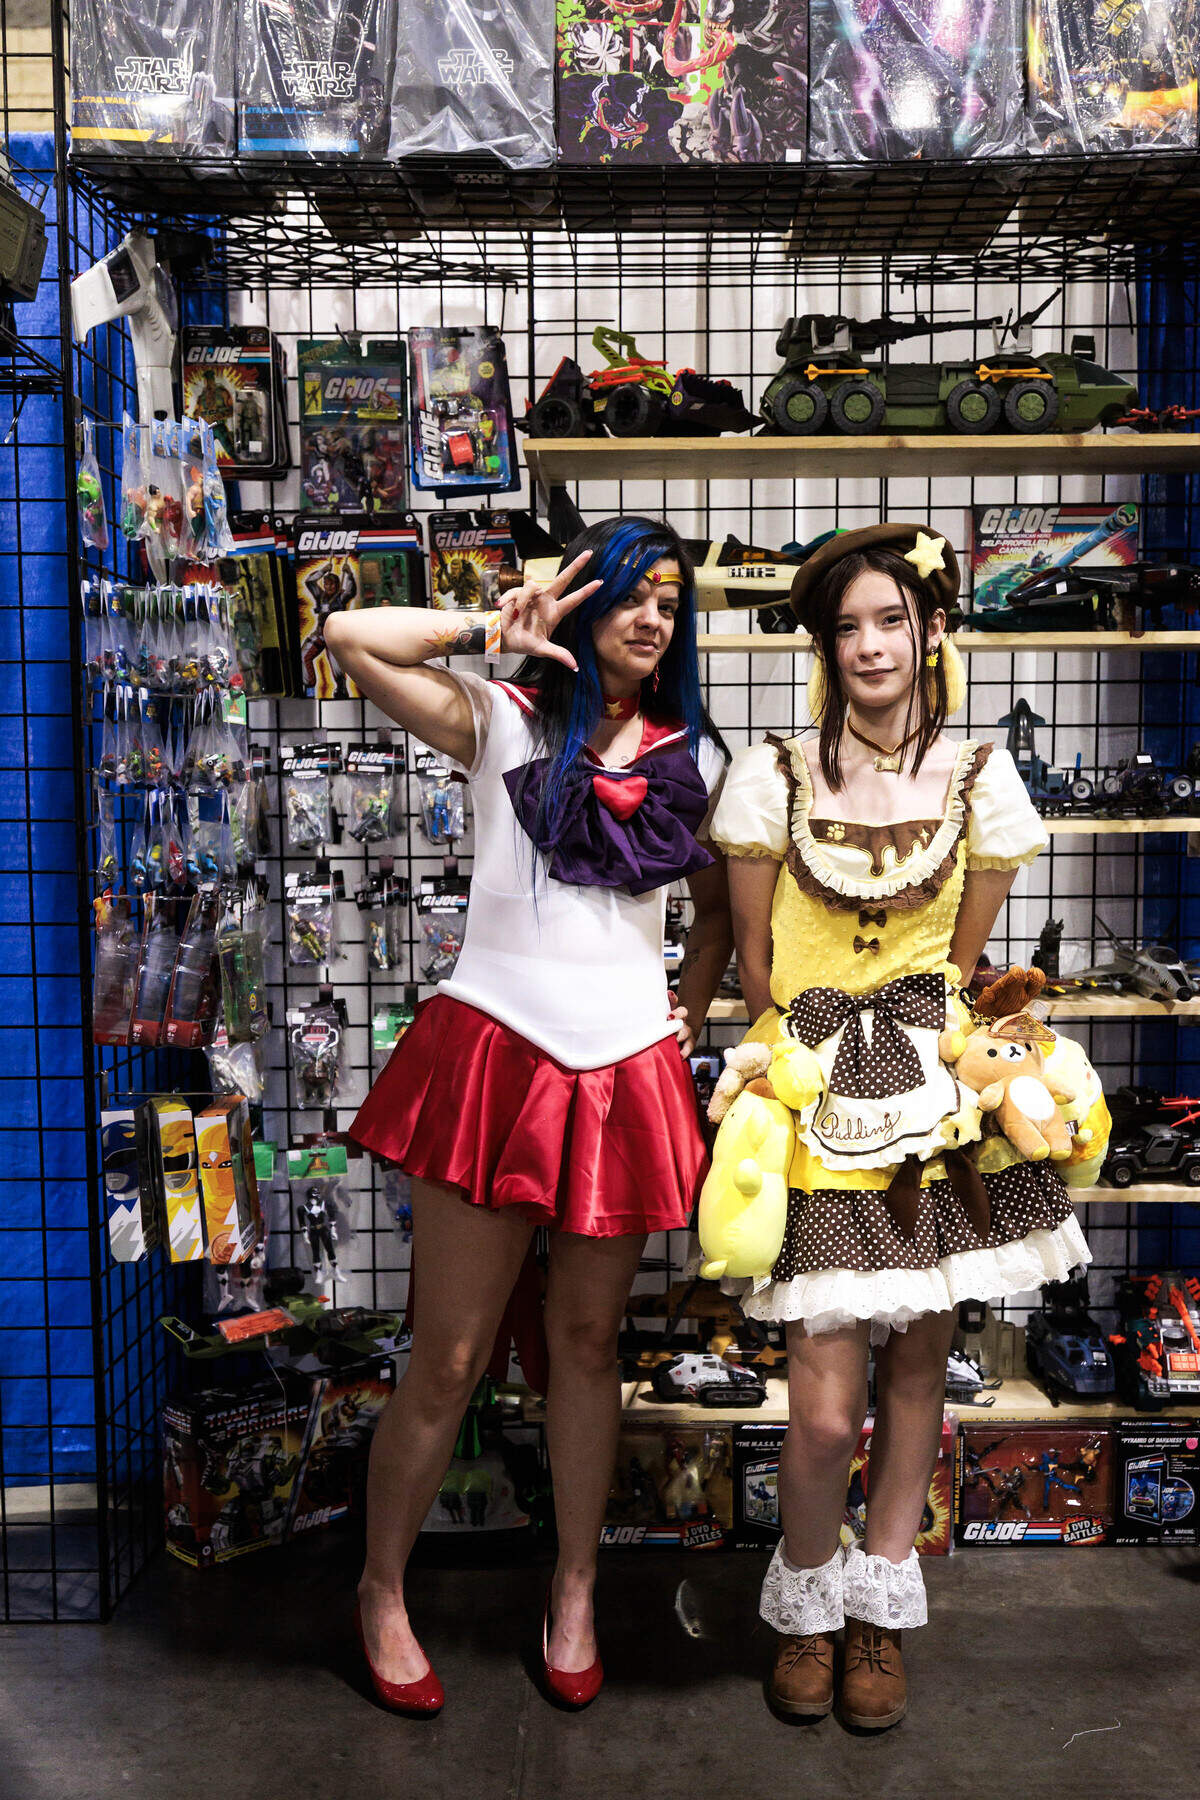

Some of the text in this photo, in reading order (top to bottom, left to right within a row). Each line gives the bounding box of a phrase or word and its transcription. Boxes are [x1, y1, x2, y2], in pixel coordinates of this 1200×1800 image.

[115, 56, 189, 75] STAR
[282, 61, 357, 80] STAR
[116, 73, 190, 94] WARS
[283, 77, 357, 97] WARS
[821, 1111, 901, 1142] Pudding
[225, 1404, 309, 1438] FORMERS
[690, 1525, 710, 1536] DVD
[1063, 1525, 1104, 1543] BATTLES
[1071, 1520, 1091, 1532] DVD
[683, 1530, 722, 1546] BATTLES
